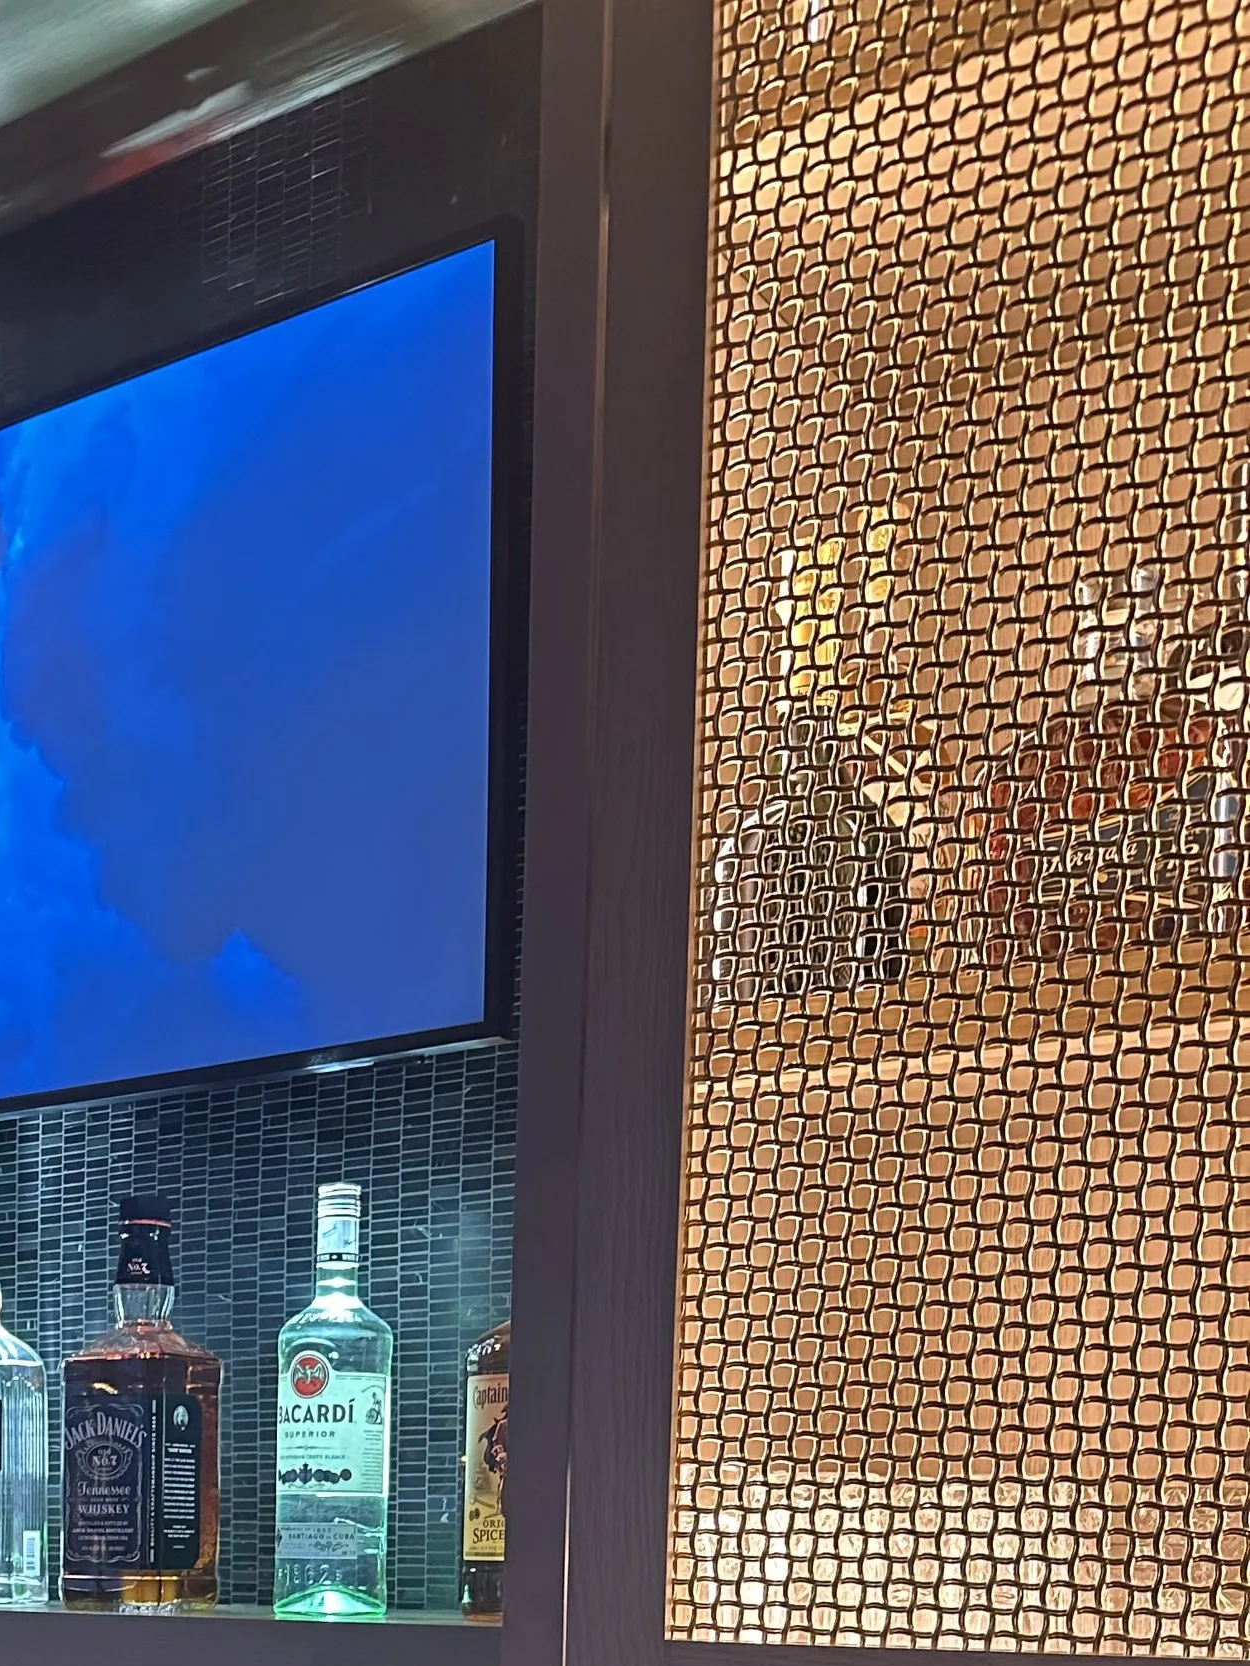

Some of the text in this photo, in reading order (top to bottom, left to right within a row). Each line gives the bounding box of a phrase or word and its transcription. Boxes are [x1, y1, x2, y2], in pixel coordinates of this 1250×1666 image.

[473, 1383, 508, 1409] Captain
[65, 1412, 148, 1450] JACK DANIEL'S
[284, 1430, 335, 1439] SUPERIOR
[77, 1481, 131, 1496] Tennessee
[77, 1504, 130, 1514] WHISKEY
